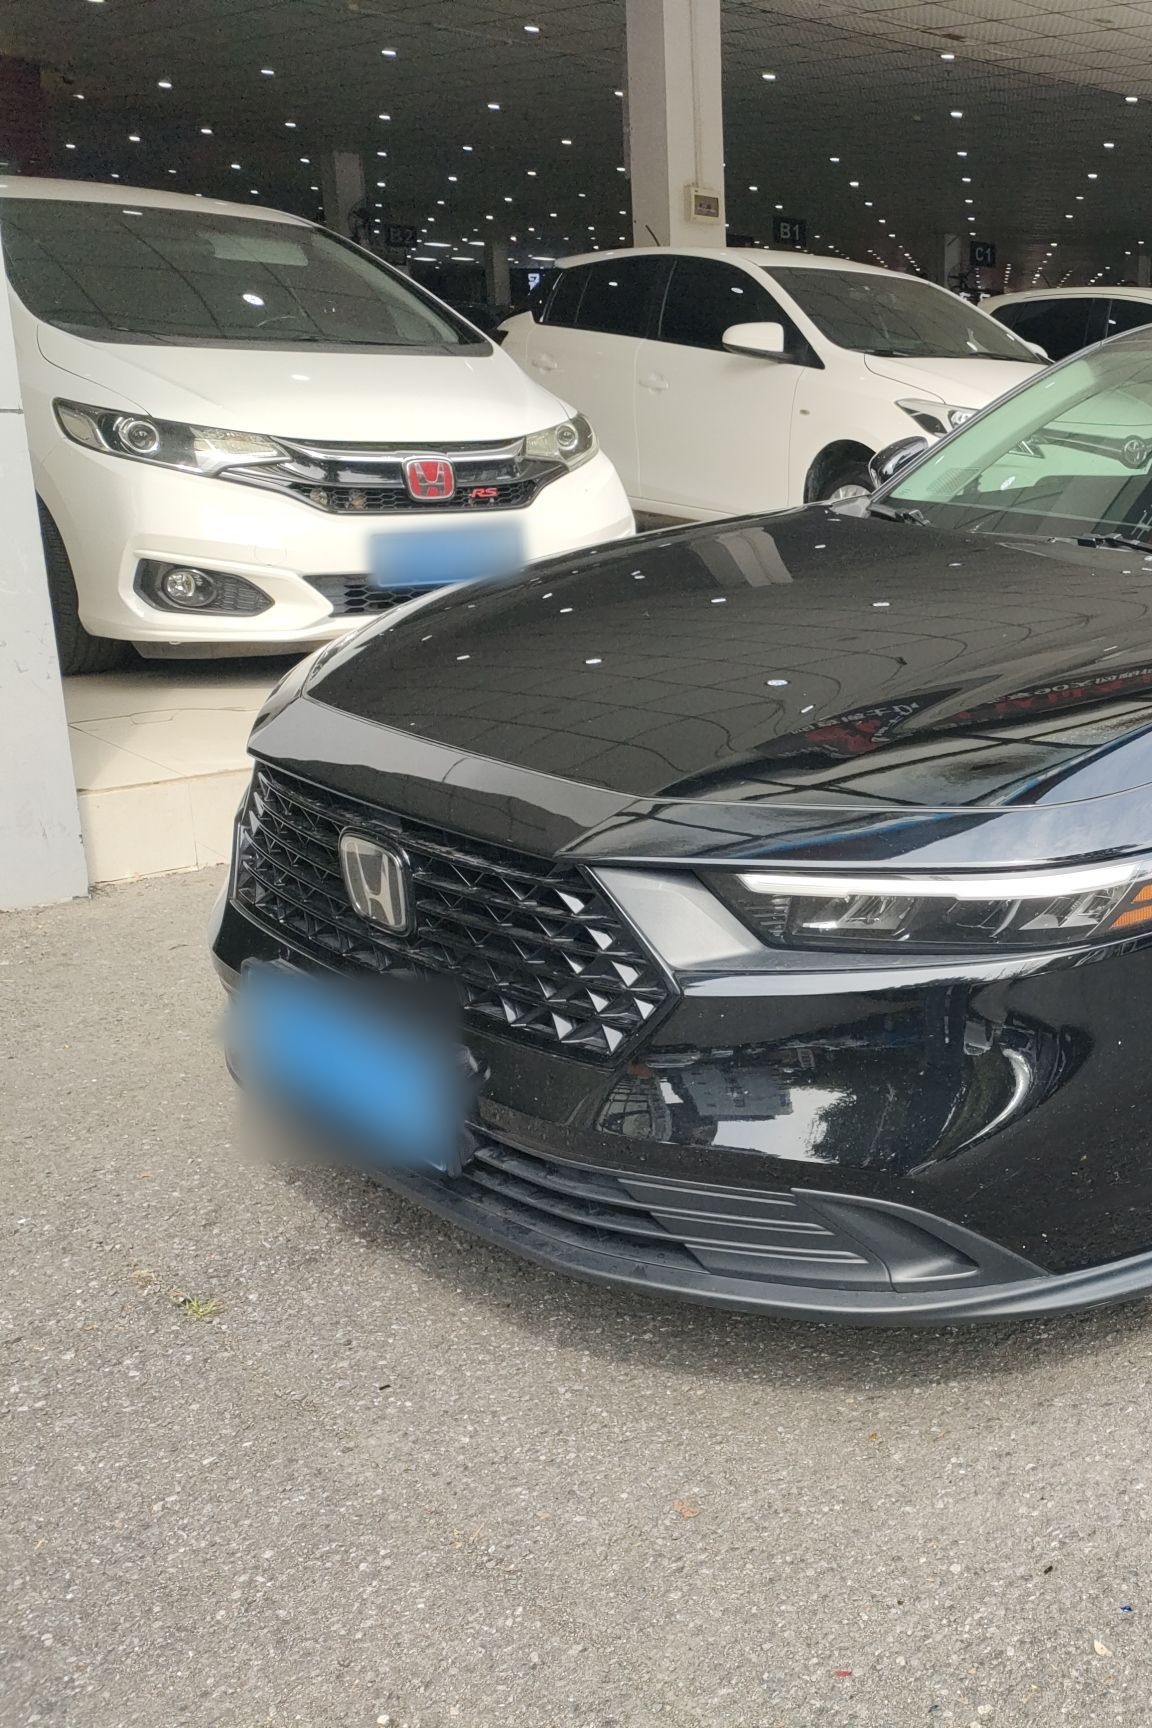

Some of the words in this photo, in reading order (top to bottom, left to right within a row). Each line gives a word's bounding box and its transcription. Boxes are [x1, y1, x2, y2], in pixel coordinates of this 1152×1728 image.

[780, 222, 799, 241] B1
[975, 247, 991, 264] C1
[471, 487, 498, 498] RS
